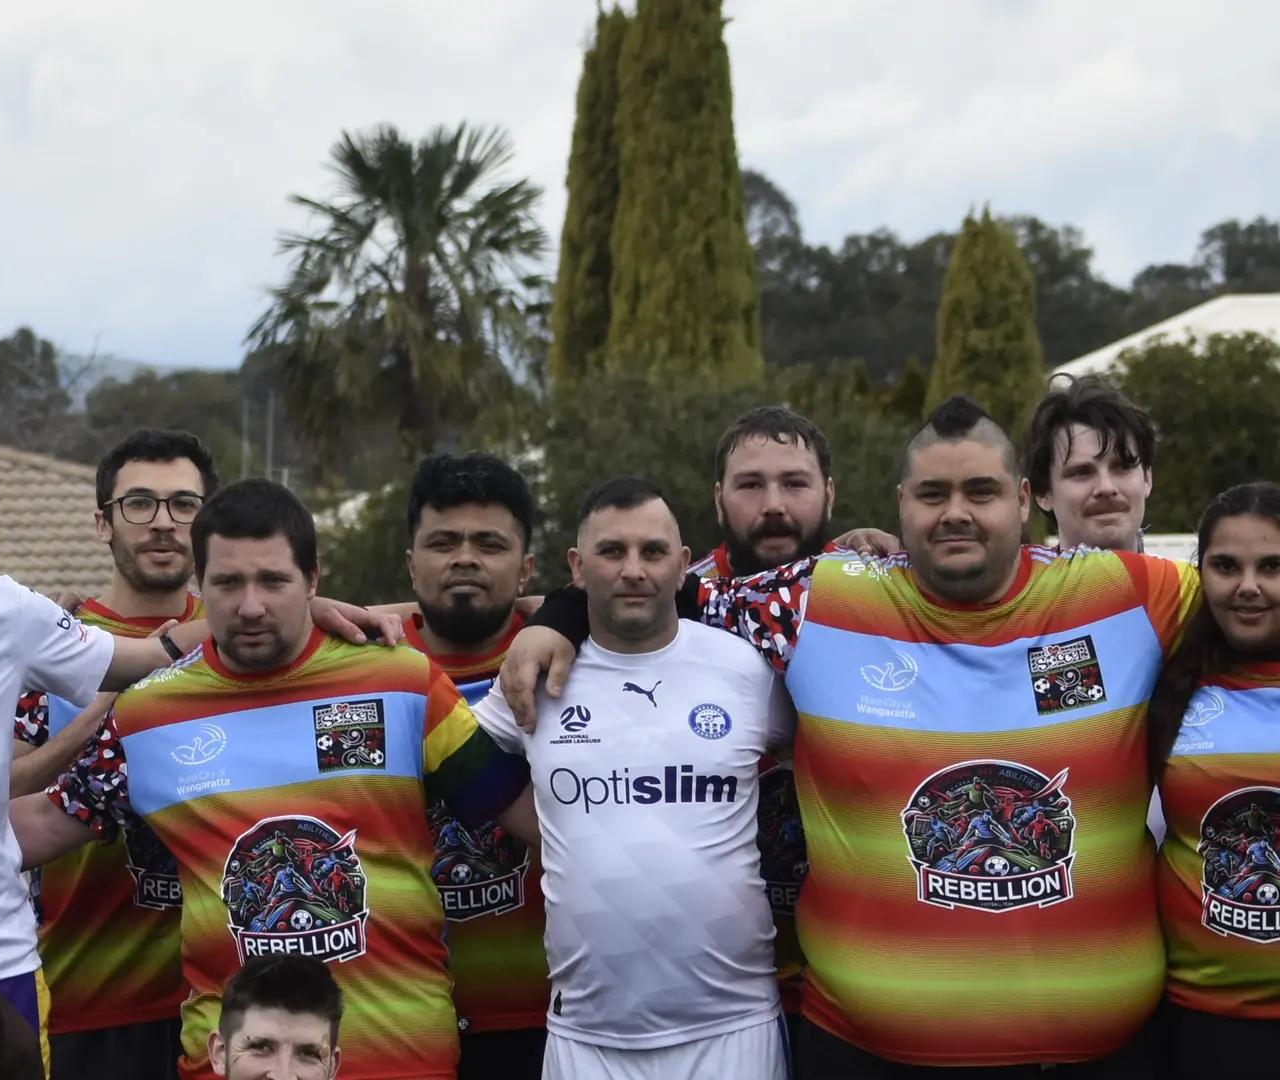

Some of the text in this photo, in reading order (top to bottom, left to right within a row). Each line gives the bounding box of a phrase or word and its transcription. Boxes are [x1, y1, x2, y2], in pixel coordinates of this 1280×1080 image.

[550, 765, 738, 813] Optislim
[444, 879, 514, 910] ELLION
[928, 871, 1061, 901] REBELLION
[244, 926, 357, 956] REBELLION
